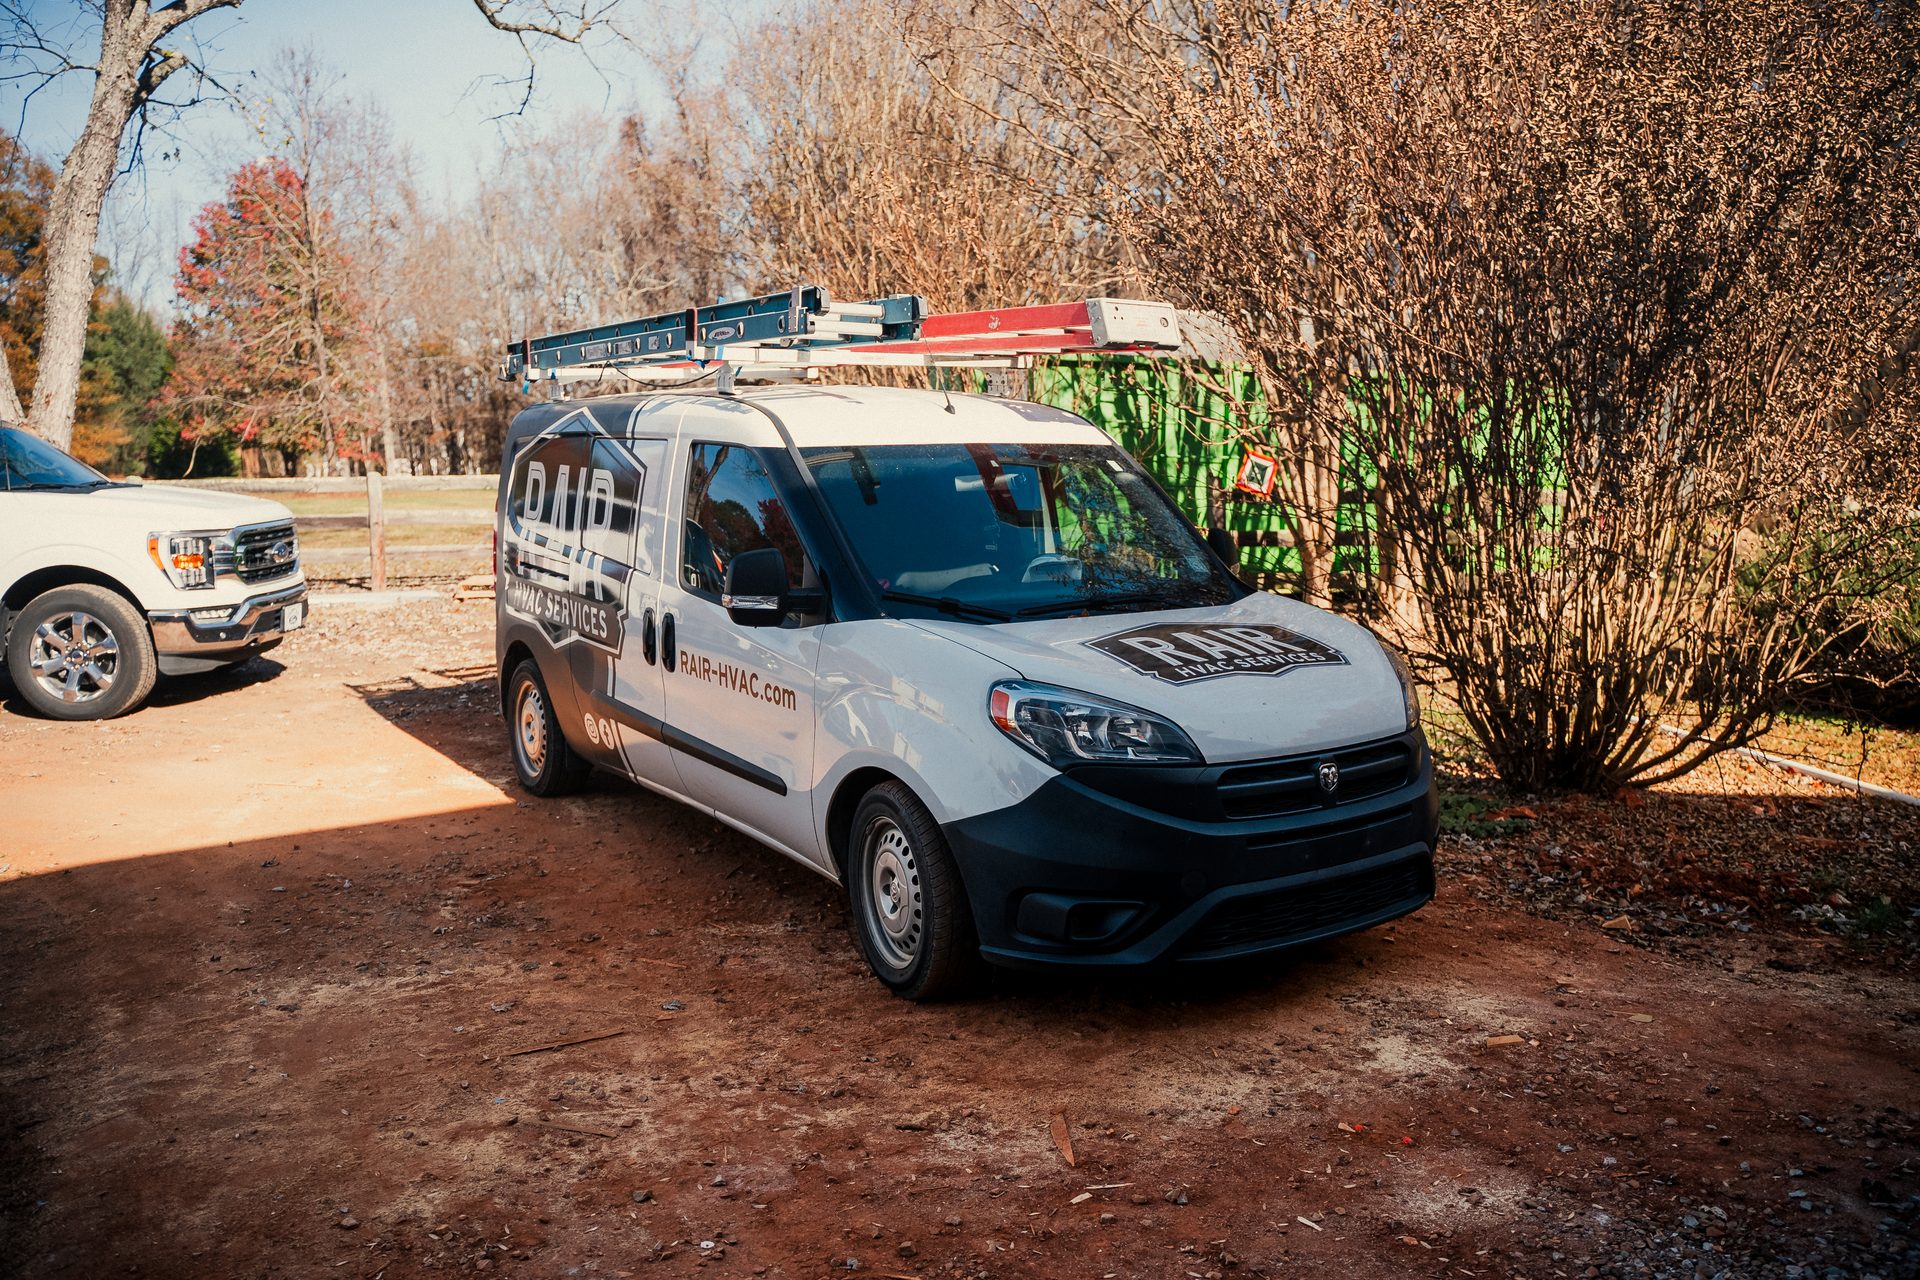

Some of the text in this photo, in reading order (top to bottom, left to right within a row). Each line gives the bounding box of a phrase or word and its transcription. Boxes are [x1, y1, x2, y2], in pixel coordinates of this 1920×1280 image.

[513, 580, 608, 639] HVAC SERVICES
[1118, 627, 1307, 667] RAIR
[1174, 652, 1327, 678] HVAC SERVICES
[680, 650, 797, 711] RAIR-HVAC.com
